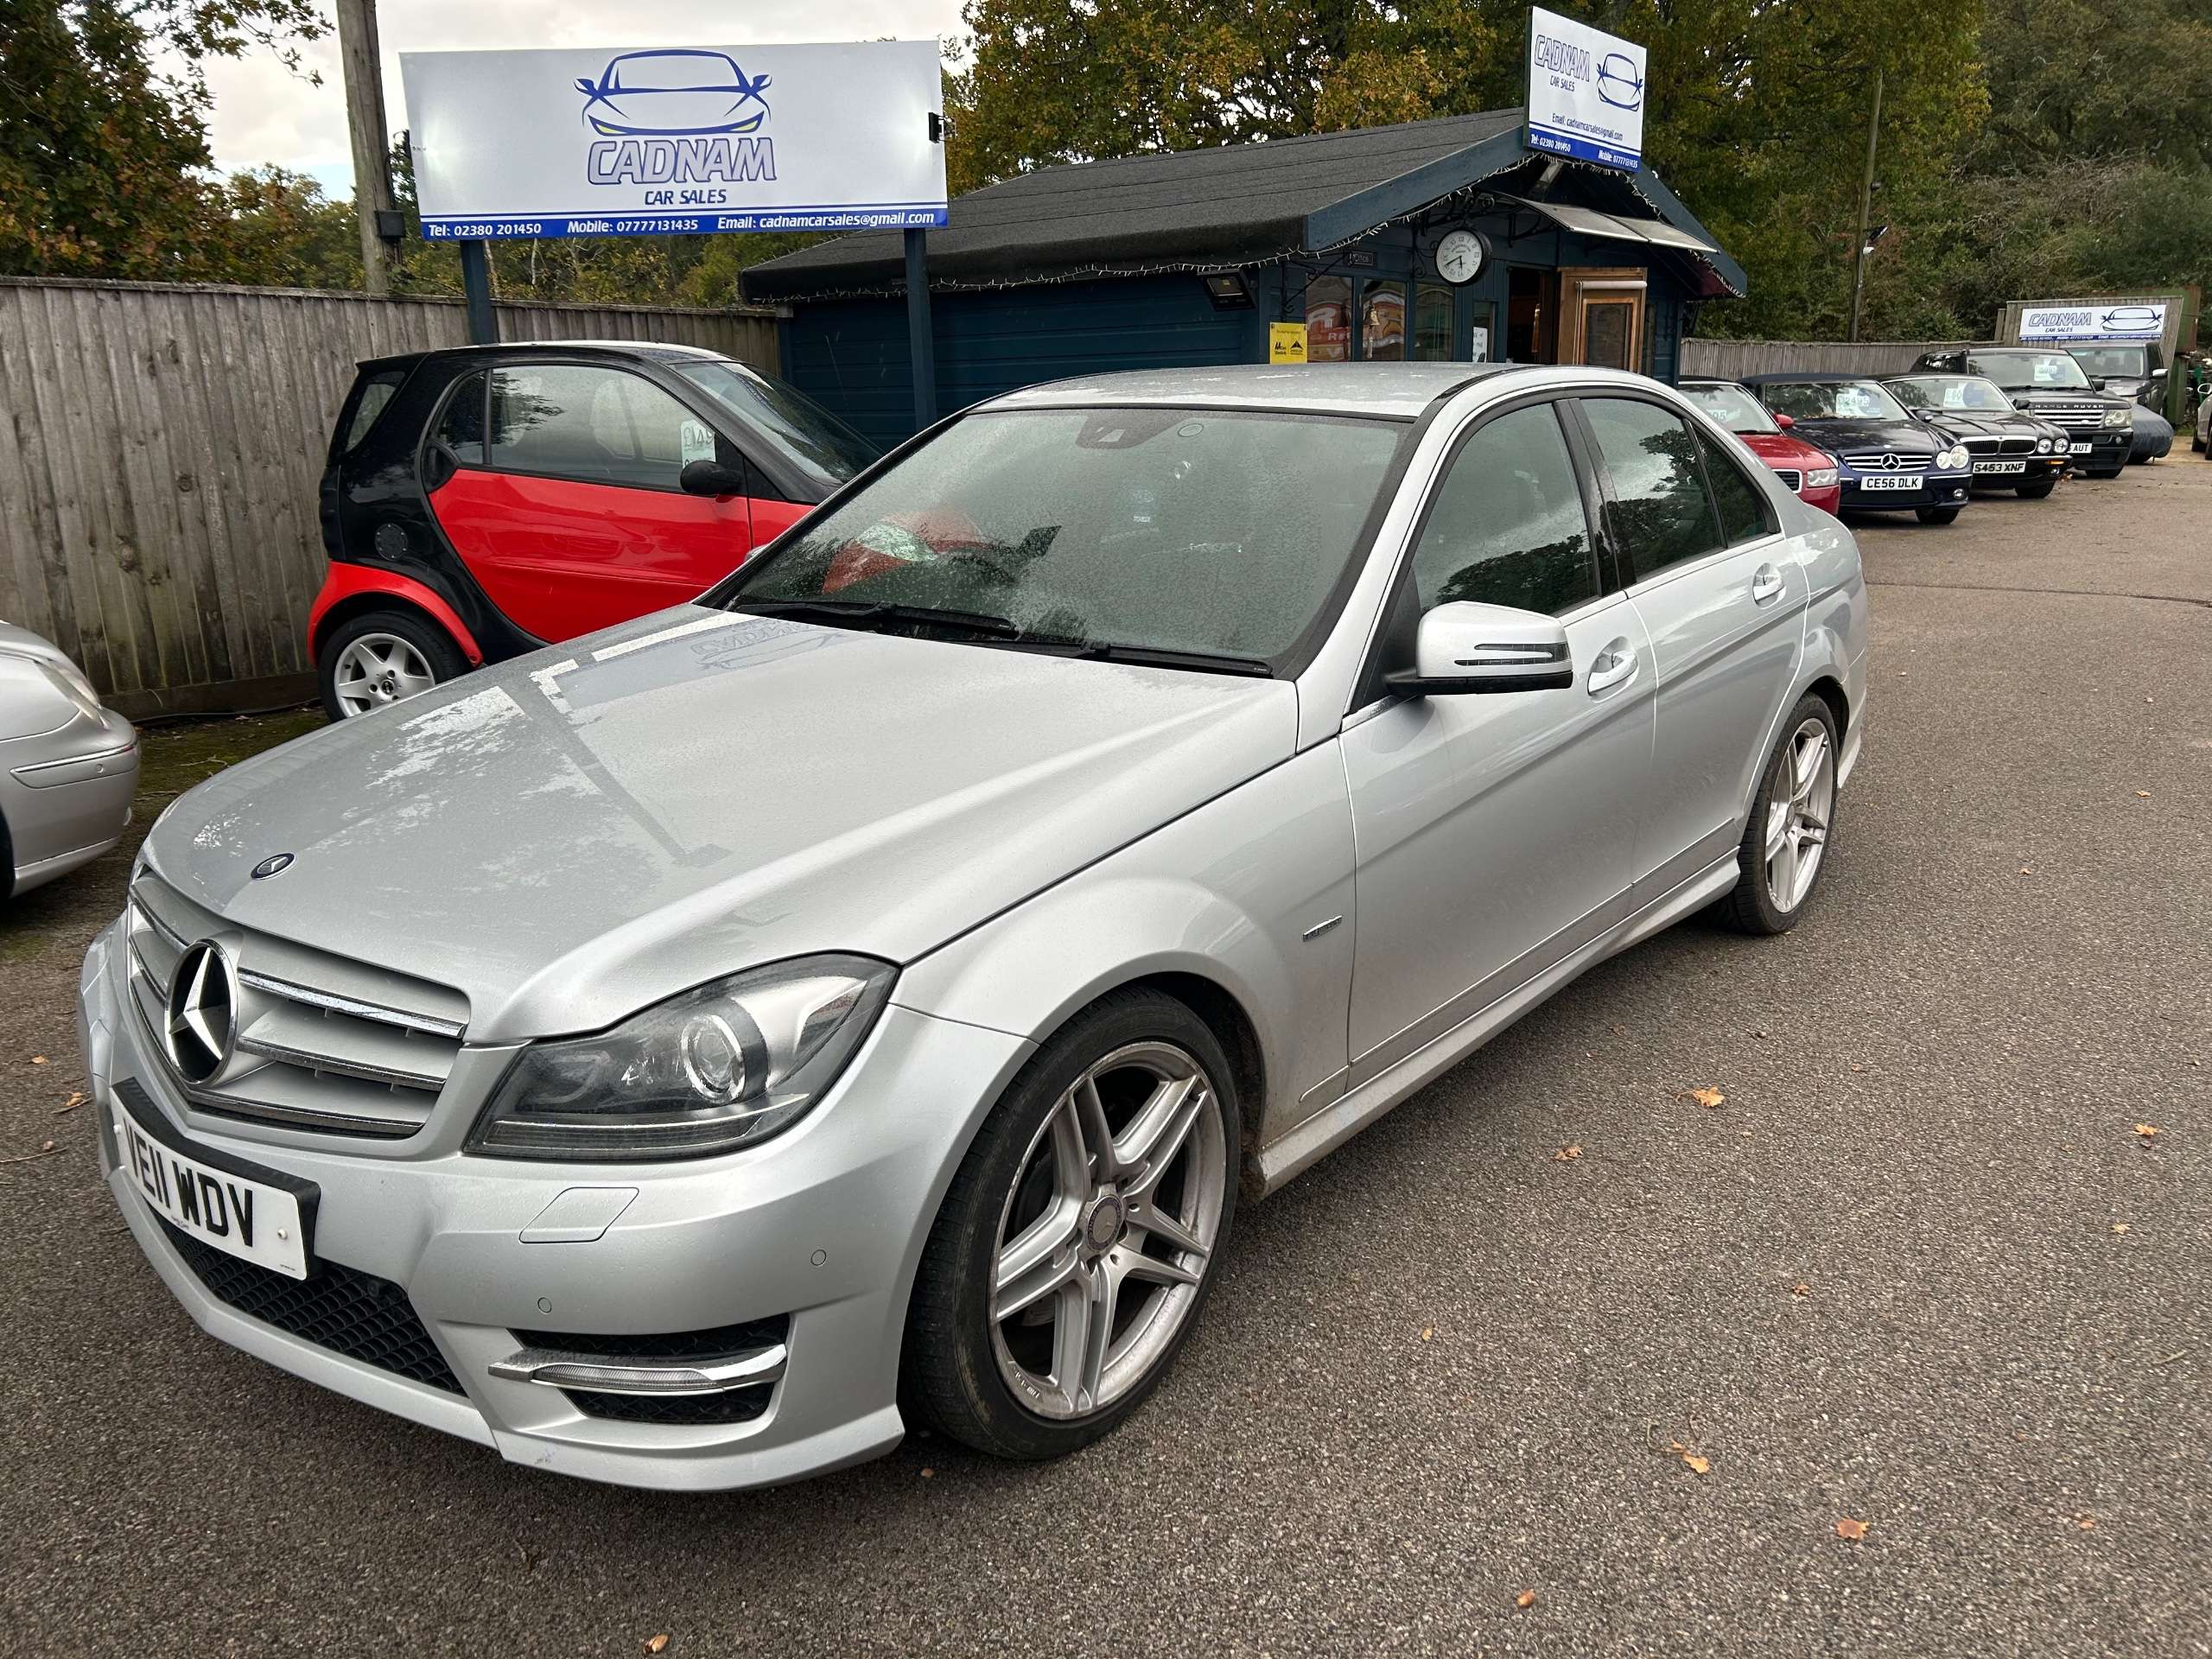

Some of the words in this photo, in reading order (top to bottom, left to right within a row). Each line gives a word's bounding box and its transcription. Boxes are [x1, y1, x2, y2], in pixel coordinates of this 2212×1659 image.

[1534, 35, 1590, 82] CADNAM
[1549, 75, 1559, 89] CAR
[1560, 79, 1575, 92] SALES
[588, 137, 777, 184] CADNAM
[645, 191, 674, 206] CAR
[679, 189, 727, 204] SALES
[429, 224, 450, 236] Tel:
[454, 225, 493, 236] 02380
[496, 223, 542, 235] 201450
[567, 219, 613, 233] Mobile:
[616, 219, 698, 232] 07777131435
[718, 216, 756, 229] Email:
[760, 212, 935, 228] cadnamcarsales@gmail.com
[2028, 312, 2092, 327] CADNAM
[1974, 463, 2002, 473] S453
[2004, 463, 2024, 472] XNF
[1866, 478, 1895, 488] CE56
[1897, 477, 1918, 488] DLK
[172, 1160, 253, 1248] WDV
